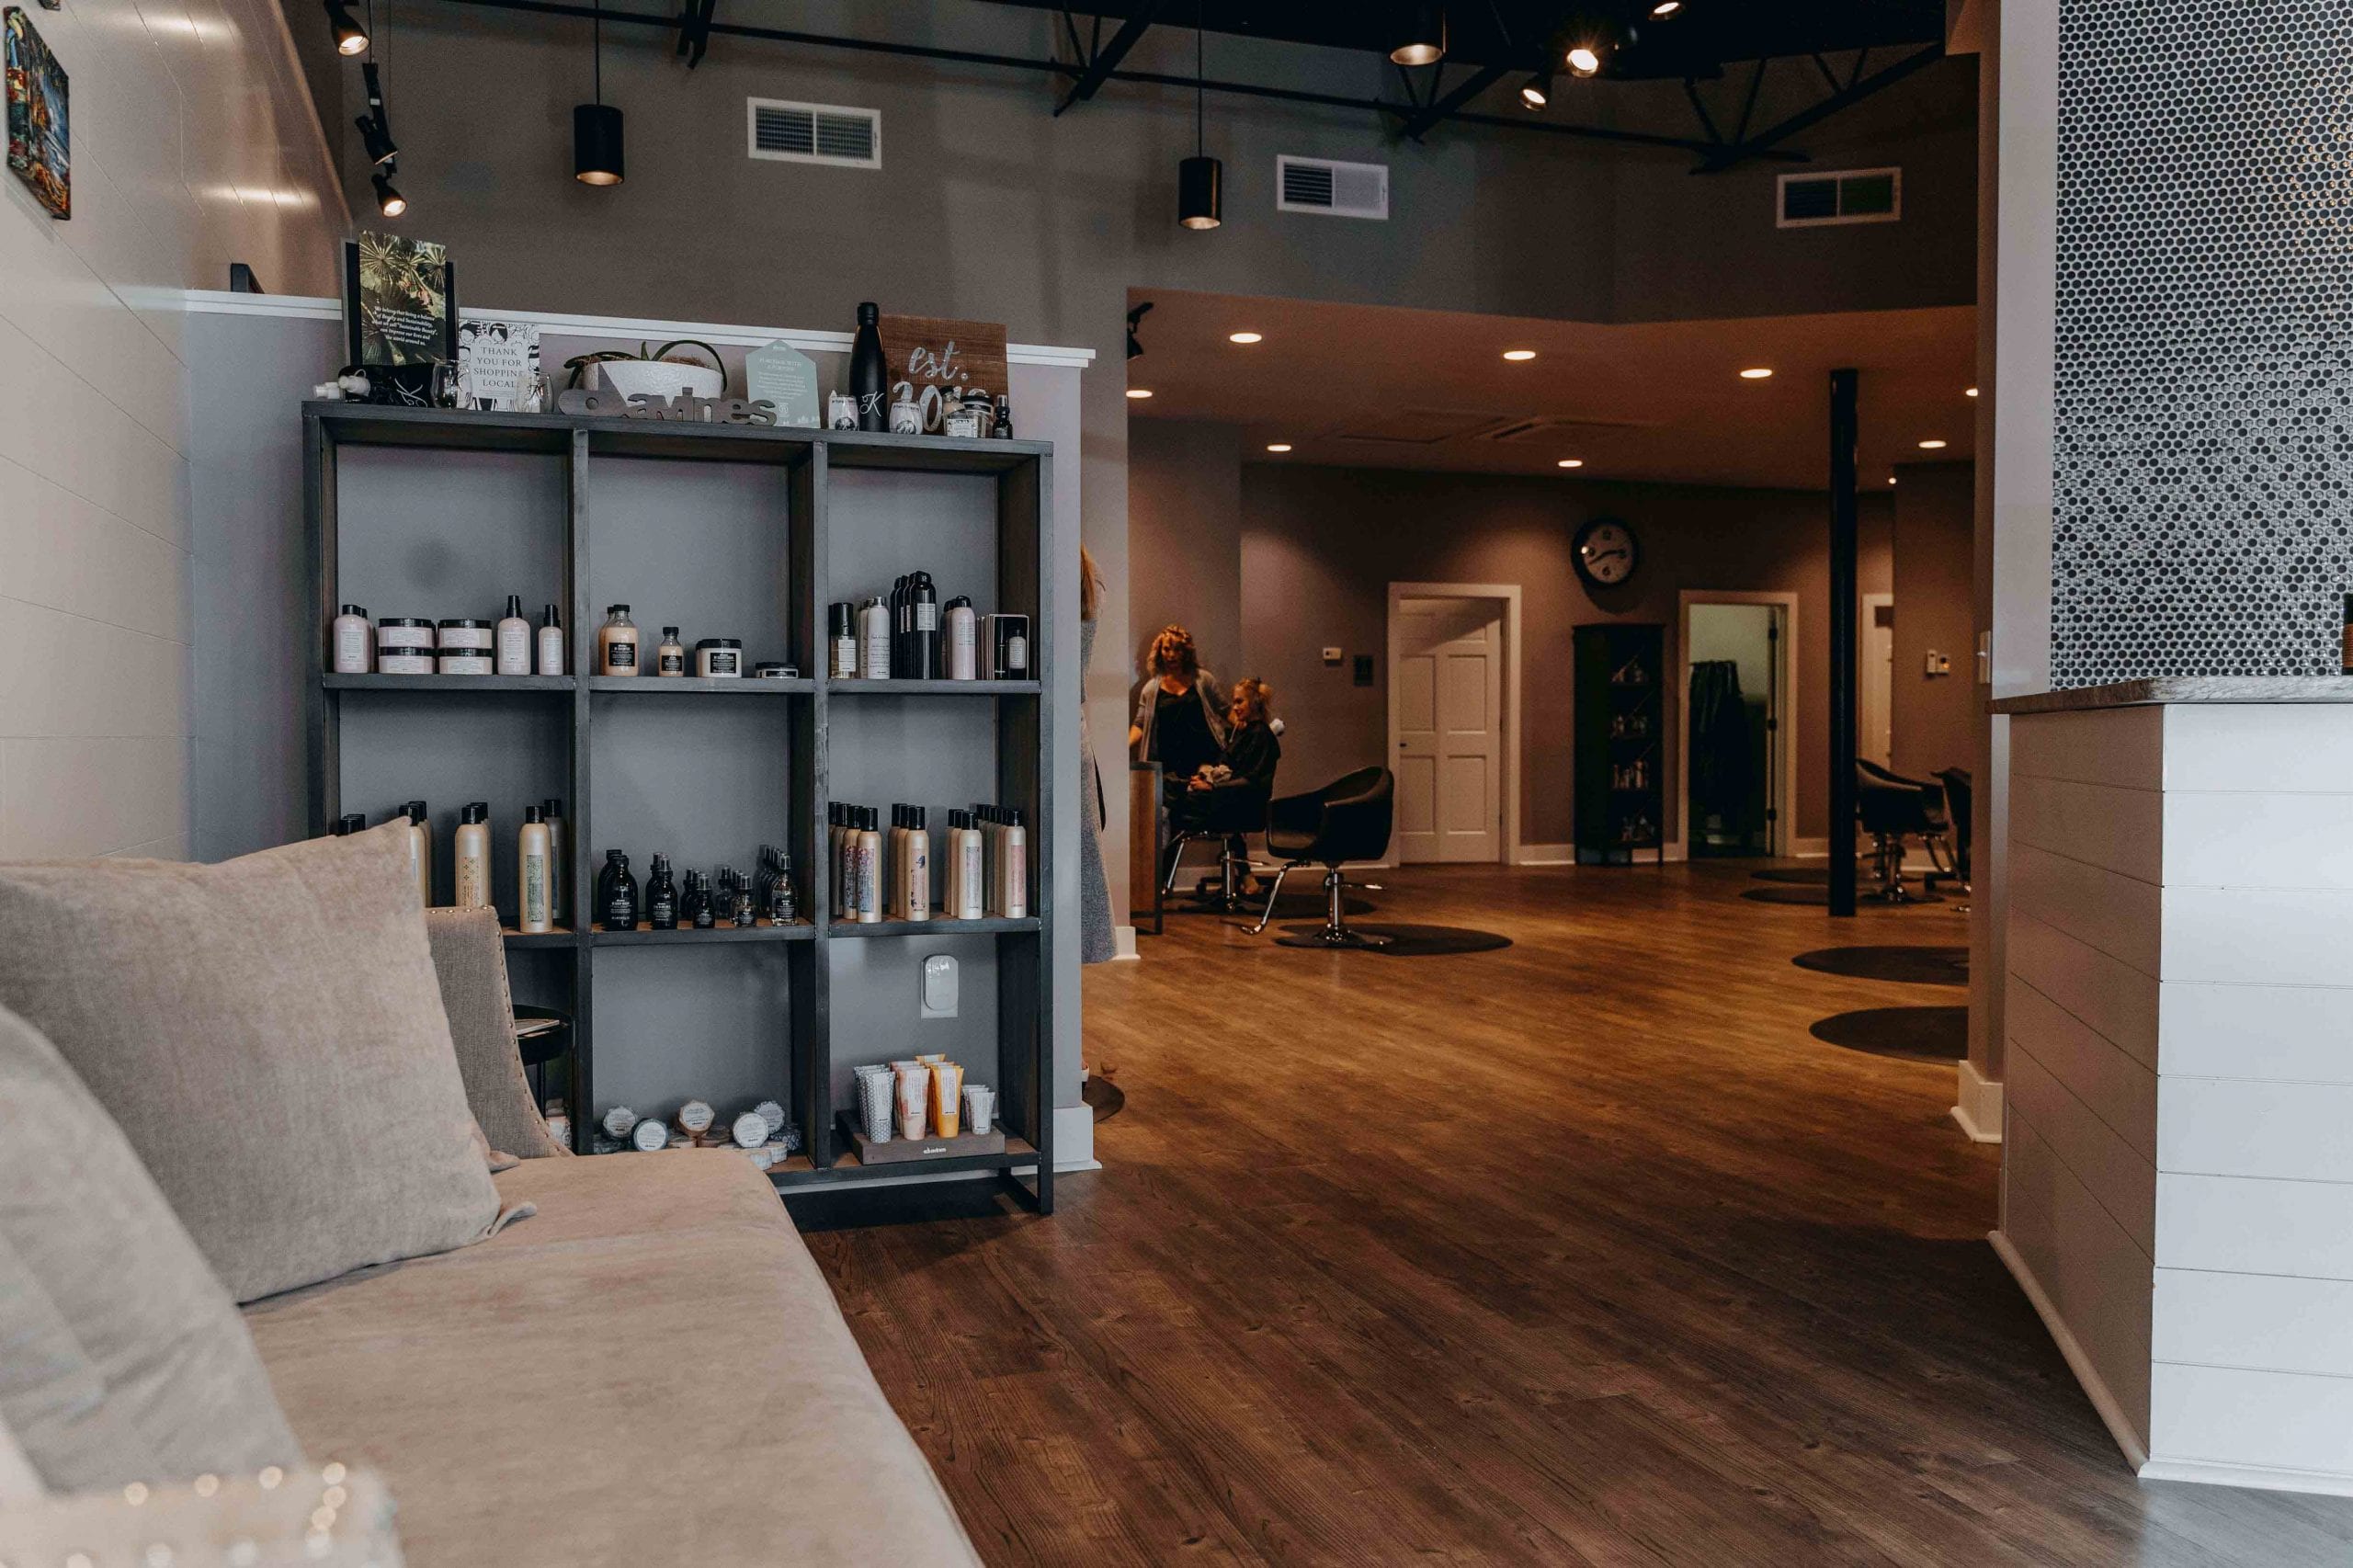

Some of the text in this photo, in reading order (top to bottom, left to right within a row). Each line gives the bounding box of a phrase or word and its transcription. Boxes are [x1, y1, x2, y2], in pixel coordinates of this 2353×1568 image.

[481, 347, 517, 356] THANK
[477, 357, 522, 367] YOU FOR
[908, 340, 969, 381] est.
